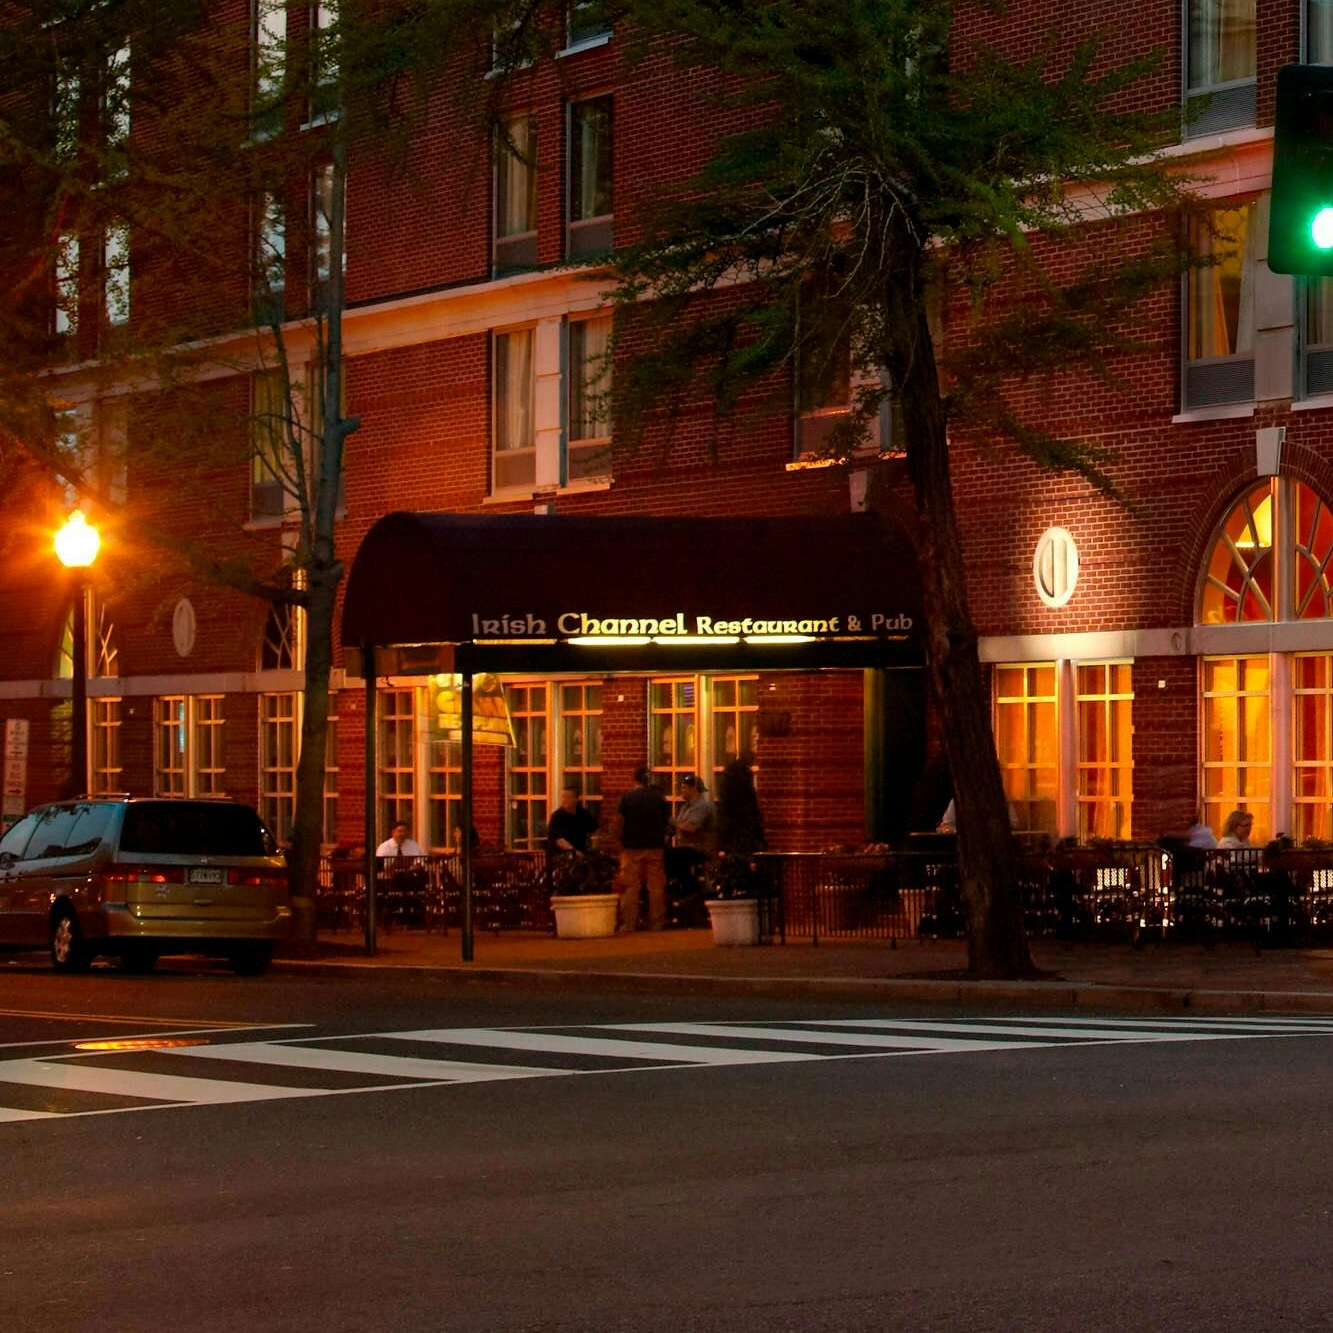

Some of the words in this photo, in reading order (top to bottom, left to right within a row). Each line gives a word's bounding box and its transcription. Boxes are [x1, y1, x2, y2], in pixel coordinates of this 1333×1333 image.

[557, 612, 688, 635] Channel
[848, 615, 862, 631] &
[872, 613, 913, 632] Pub
